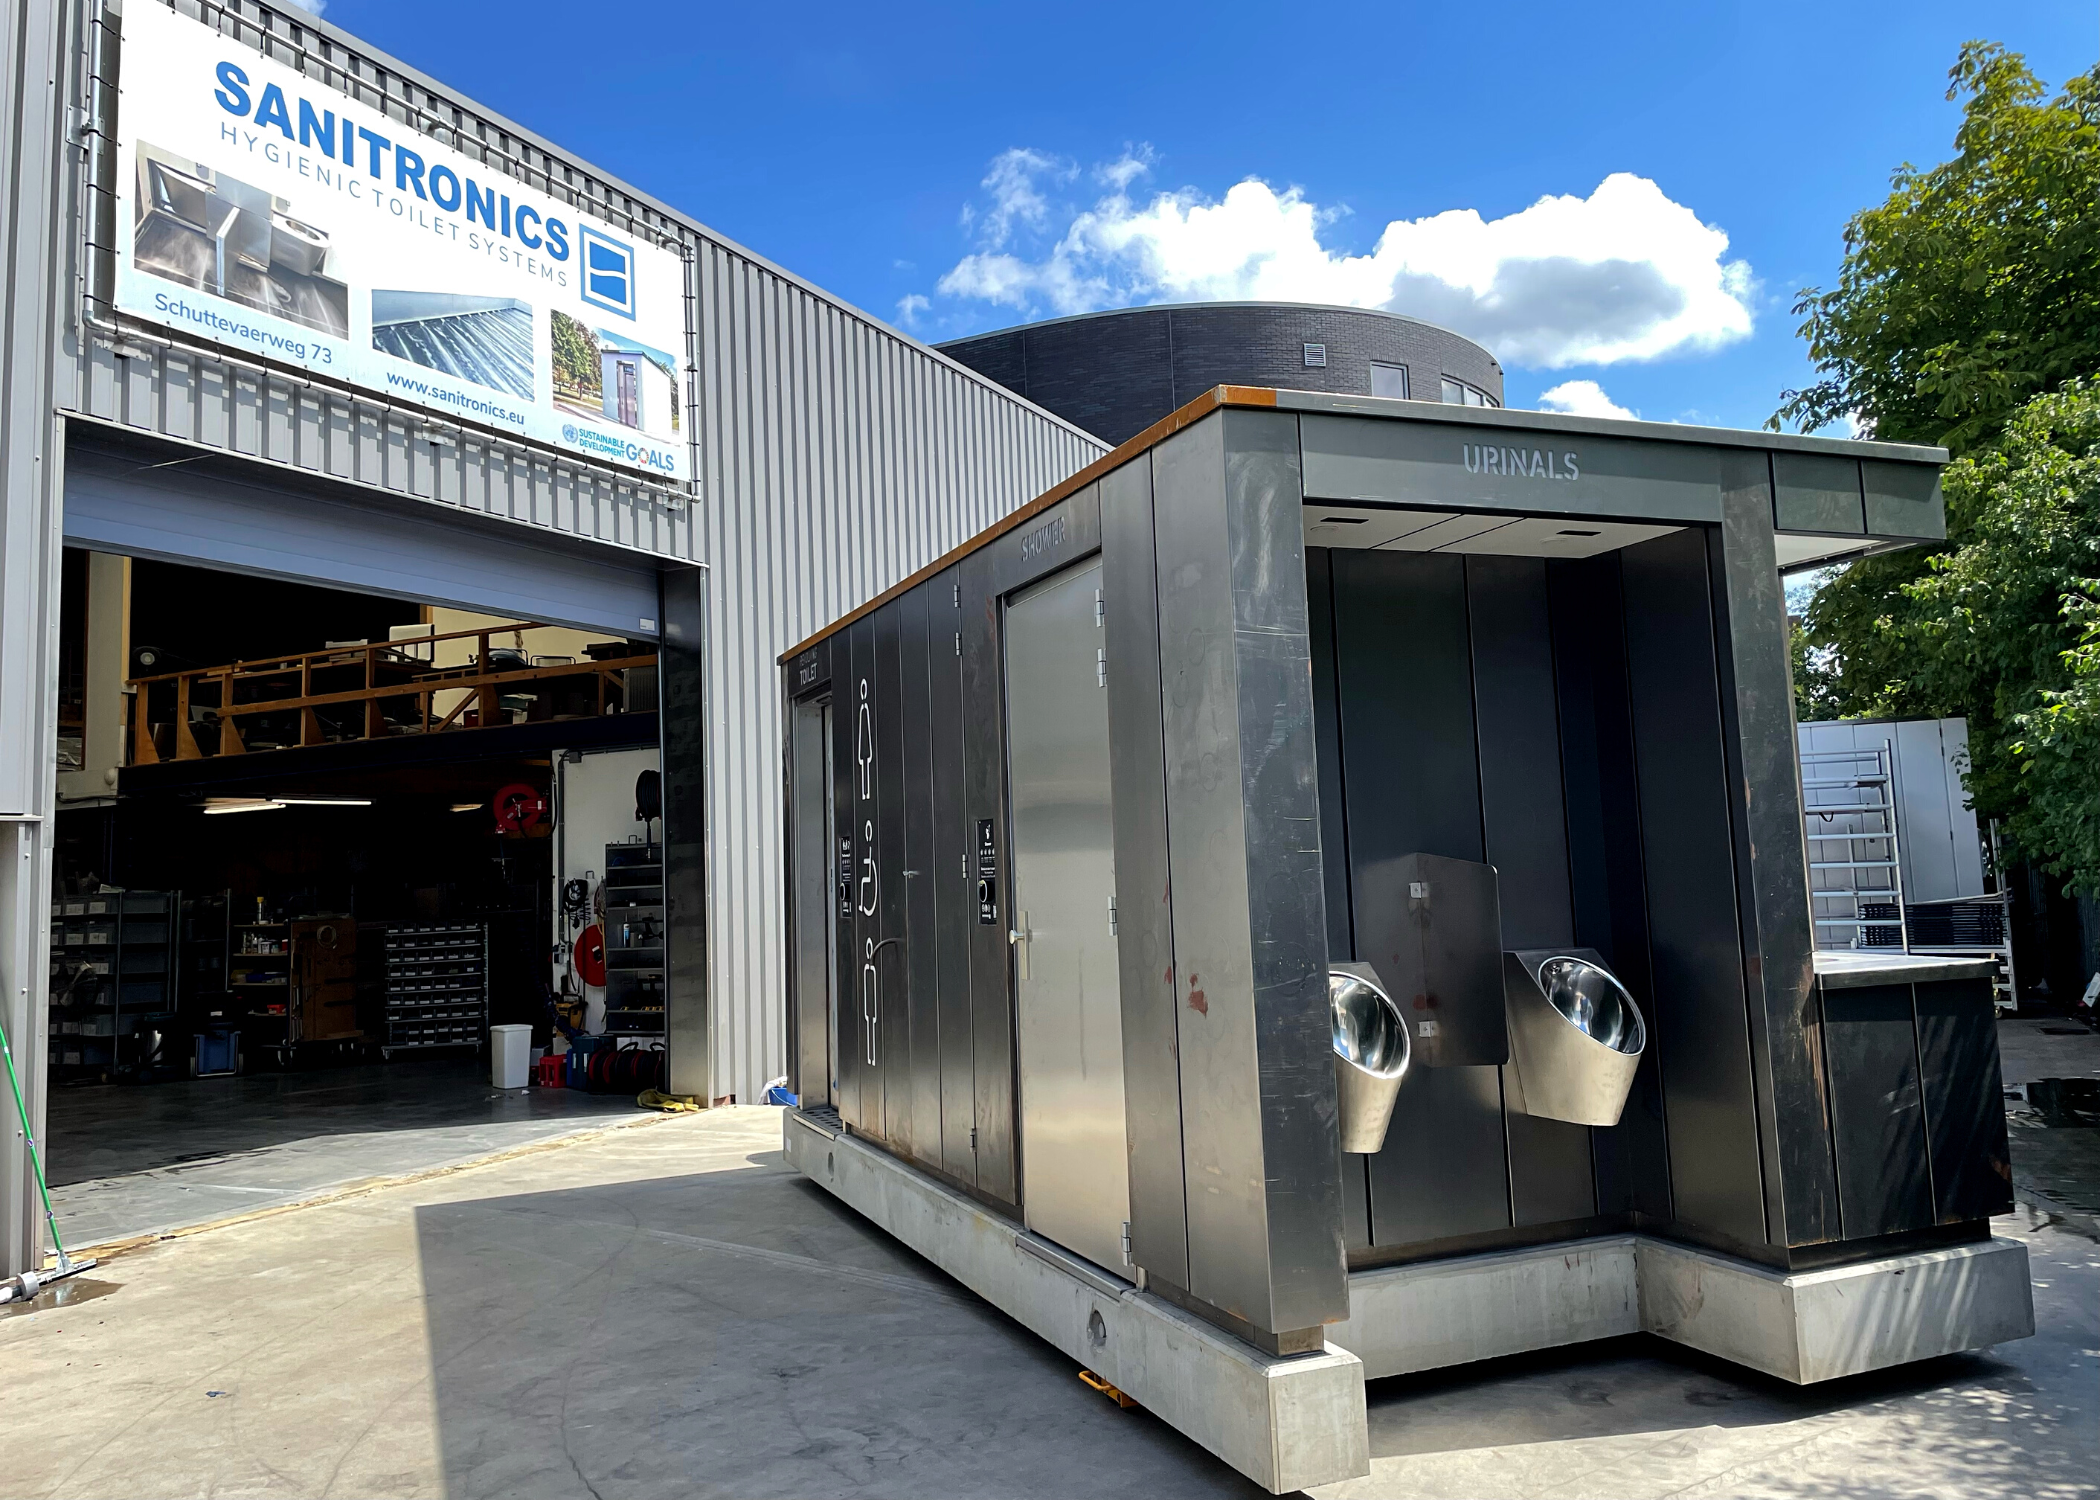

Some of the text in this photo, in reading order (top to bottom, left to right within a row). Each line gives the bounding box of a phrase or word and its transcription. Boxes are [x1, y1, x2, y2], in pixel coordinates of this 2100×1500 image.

[214, 61, 570, 262] SANITRONICS
[221, 121, 568, 287] HYGIENIC TOILET SYSTEMS
[155, 293, 332, 364] Schuttevaerweg 73
[386, 371, 525, 425] www.sanitronics.eu
[579, 428, 625, 449] SUSTAINABLE
[579, 438, 625, 458] DEVELOPMENT
[626, 443, 675, 472] GOALS
[1463, 443, 1580, 481] URINALS
[1021, 516, 1066, 562] SHOWER
[799, 662, 818, 686] TOILET
